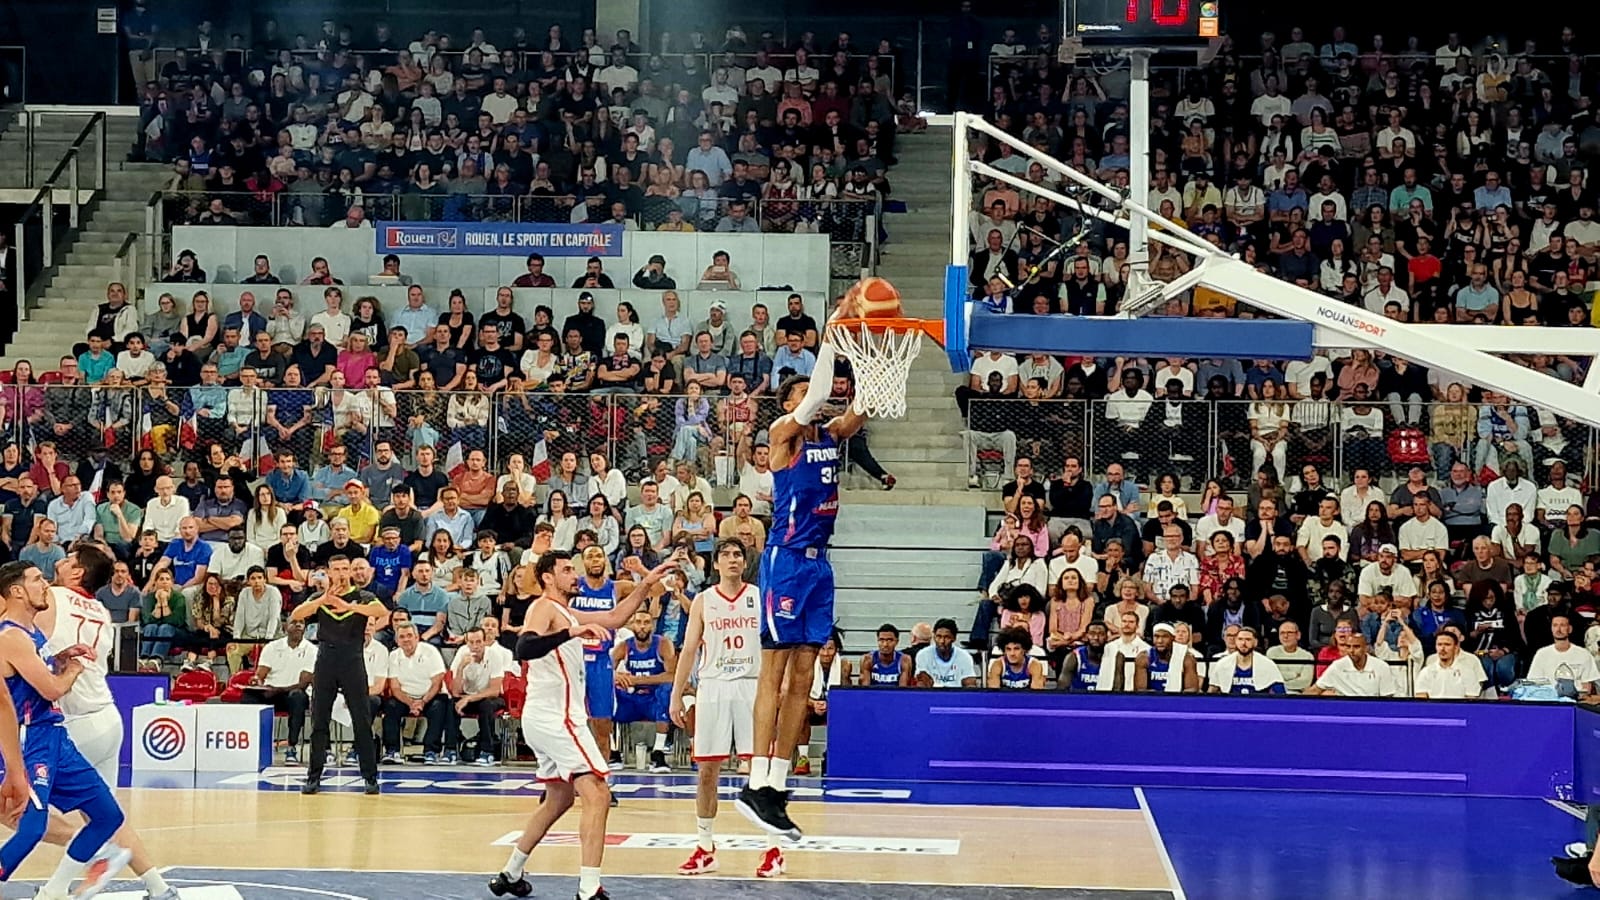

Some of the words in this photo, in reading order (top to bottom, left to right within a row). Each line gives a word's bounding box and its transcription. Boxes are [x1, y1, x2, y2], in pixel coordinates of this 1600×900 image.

[395, 231, 434, 245] Rouen
[465, 232, 500, 247] ROUEN,
[503, 233, 516, 247] LE
[517, 233, 549, 247] SPORT
[551, 233, 565, 247] EN
[566, 233, 612, 247] CAPITALE
[1317, 306, 1386, 337] NOUANSPORT
[806, 448, 839, 463] FRAN
[575, 596, 613, 609] FRANCE
[70, 613, 104, 649] 77
[709, 616, 758, 631] TÜRKİYE
[723, 635, 744, 649] 10
[629, 659, 656, 669] FRANCE
[206, 731, 249, 749] FFBB
